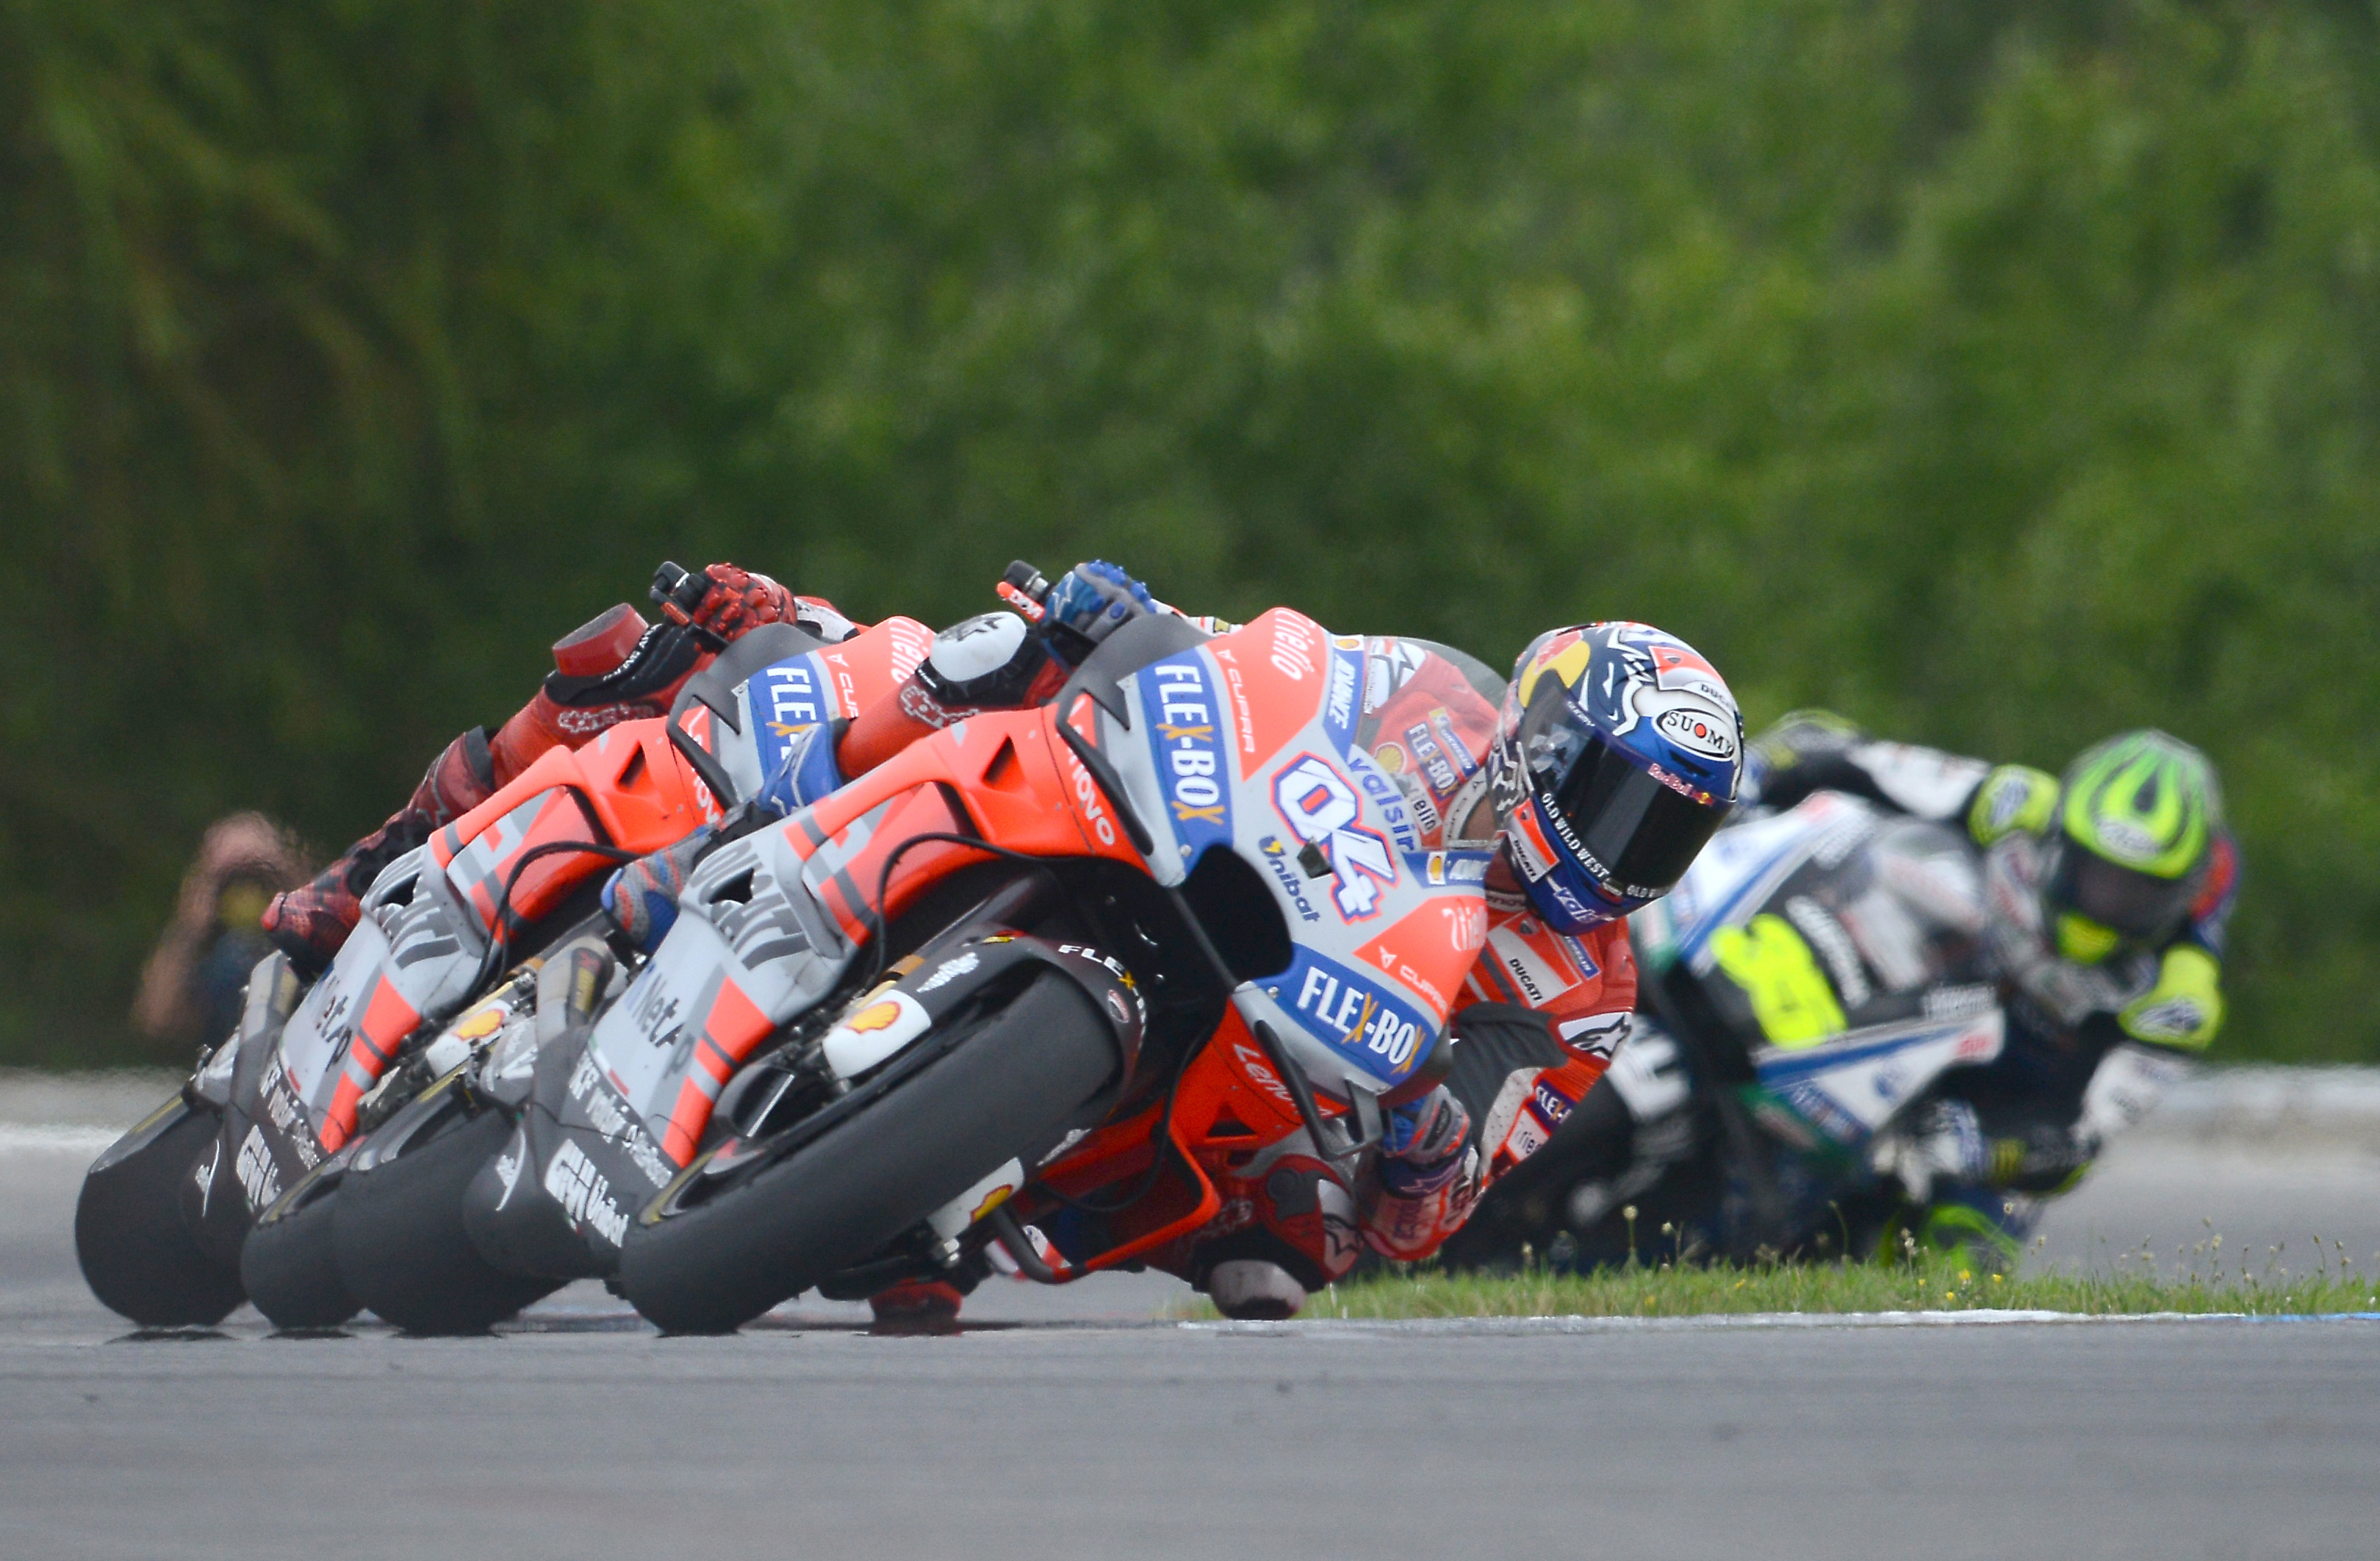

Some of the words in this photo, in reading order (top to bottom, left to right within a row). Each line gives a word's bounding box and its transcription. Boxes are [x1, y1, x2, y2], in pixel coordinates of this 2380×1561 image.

[836, 673, 859, 720] CUP
[1228, 668, 1256, 753] CUPRA
[1666, 710, 1735, 758] SUOMY
[1155, 664, 1226, 825] FLEX-BOX
[1270, 750, 1401, 925] 04
[1347, 757, 1415, 853] valsir
[1542, 792, 1558, 820] OLD
[1554, 817, 1582, 852] WILD
[1577, 848, 1611, 879] WEST
[1259, 835, 1321, 923] Unibat
[1298, 966, 1427, 1074] FLEX-BOX
[1509, 958, 1543, 1002] DUCATI
